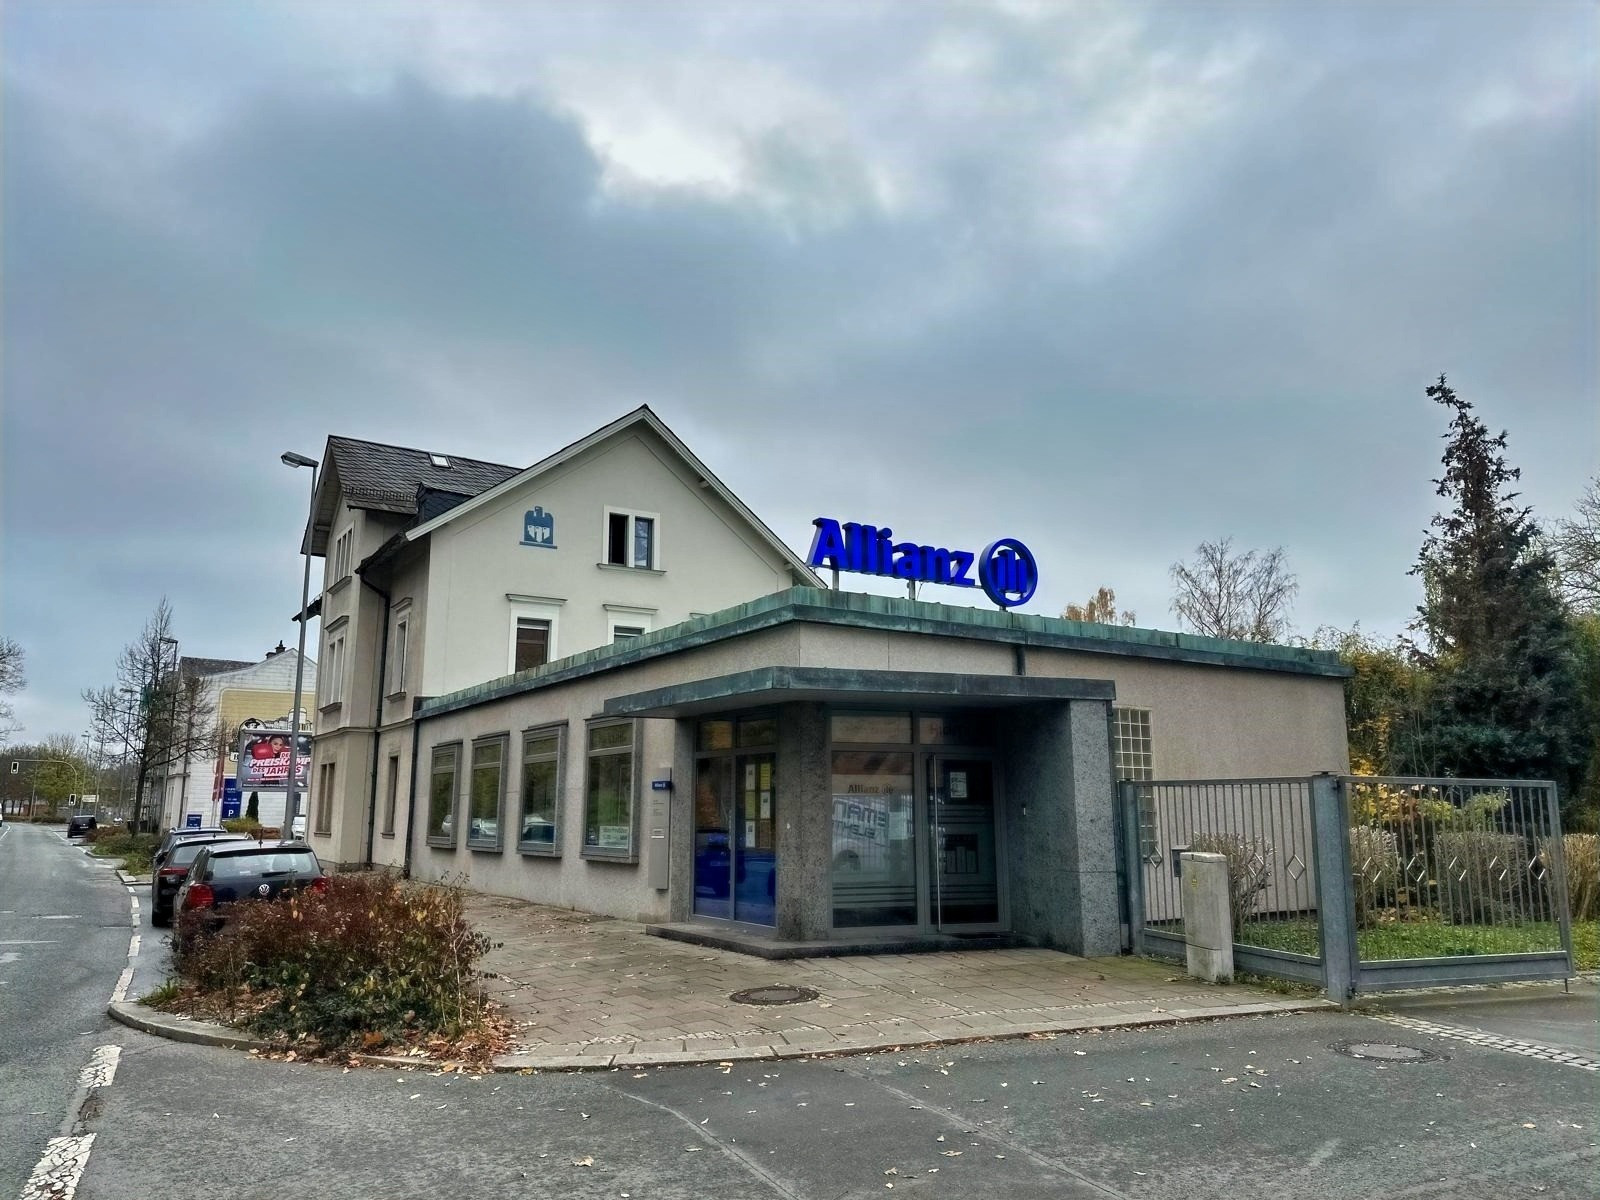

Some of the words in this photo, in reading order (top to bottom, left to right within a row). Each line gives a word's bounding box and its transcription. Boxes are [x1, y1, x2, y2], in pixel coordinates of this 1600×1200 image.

[806, 517, 975, 586] Allianz
[250, 757, 311, 767] PREISKMP
[252, 766, 265, 774] DES
[265, 766, 301, 775] JAHRS
[228, 809, 234, 817] P
